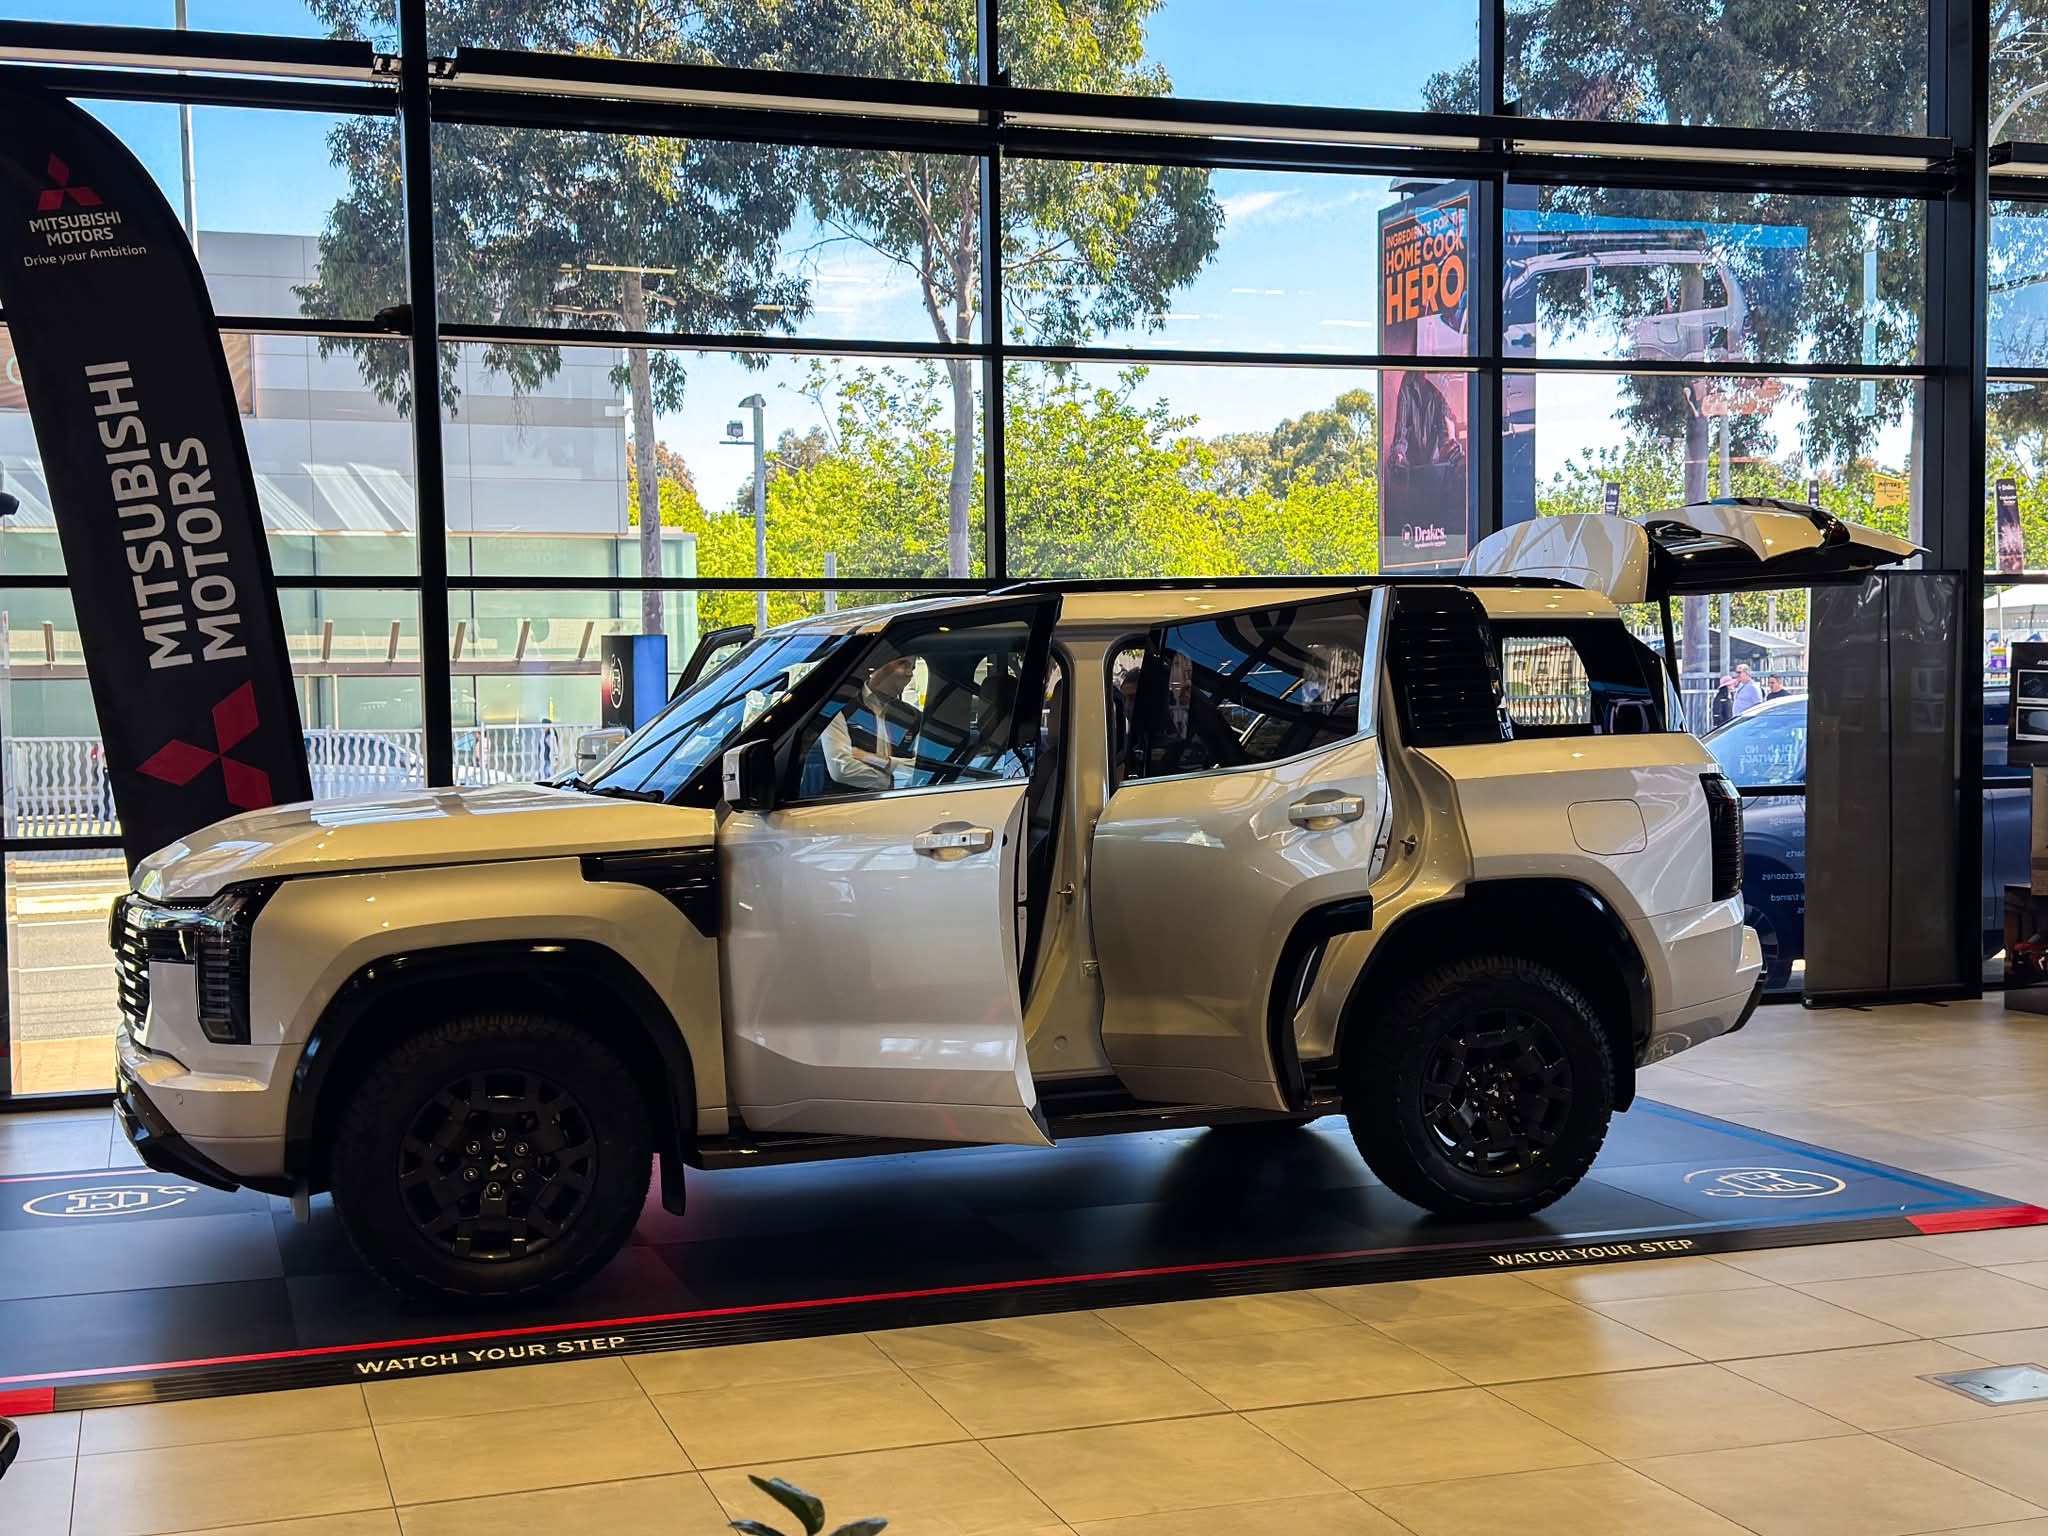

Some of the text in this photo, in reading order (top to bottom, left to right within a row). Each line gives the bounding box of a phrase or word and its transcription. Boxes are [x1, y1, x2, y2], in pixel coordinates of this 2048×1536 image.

[29, 211, 121, 232] MITSUBISHI
[46, 227, 114, 246] MOTORS
[24, 245, 147, 267] Drive your Ambition
[1386, 226, 1465, 275] HOME COOK
[1385, 255, 1465, 325] HERO
[85, 361, 193, 669] MITSUBISHI
[1414, 523, 1446, 542] Drakes
[160, 438, 247, 661] MOTORS
[1489, 1239, 1694, 1266] WATCH YOUR STEP
[356, 1336, 626, 1374] WATCH YOUR STEP
